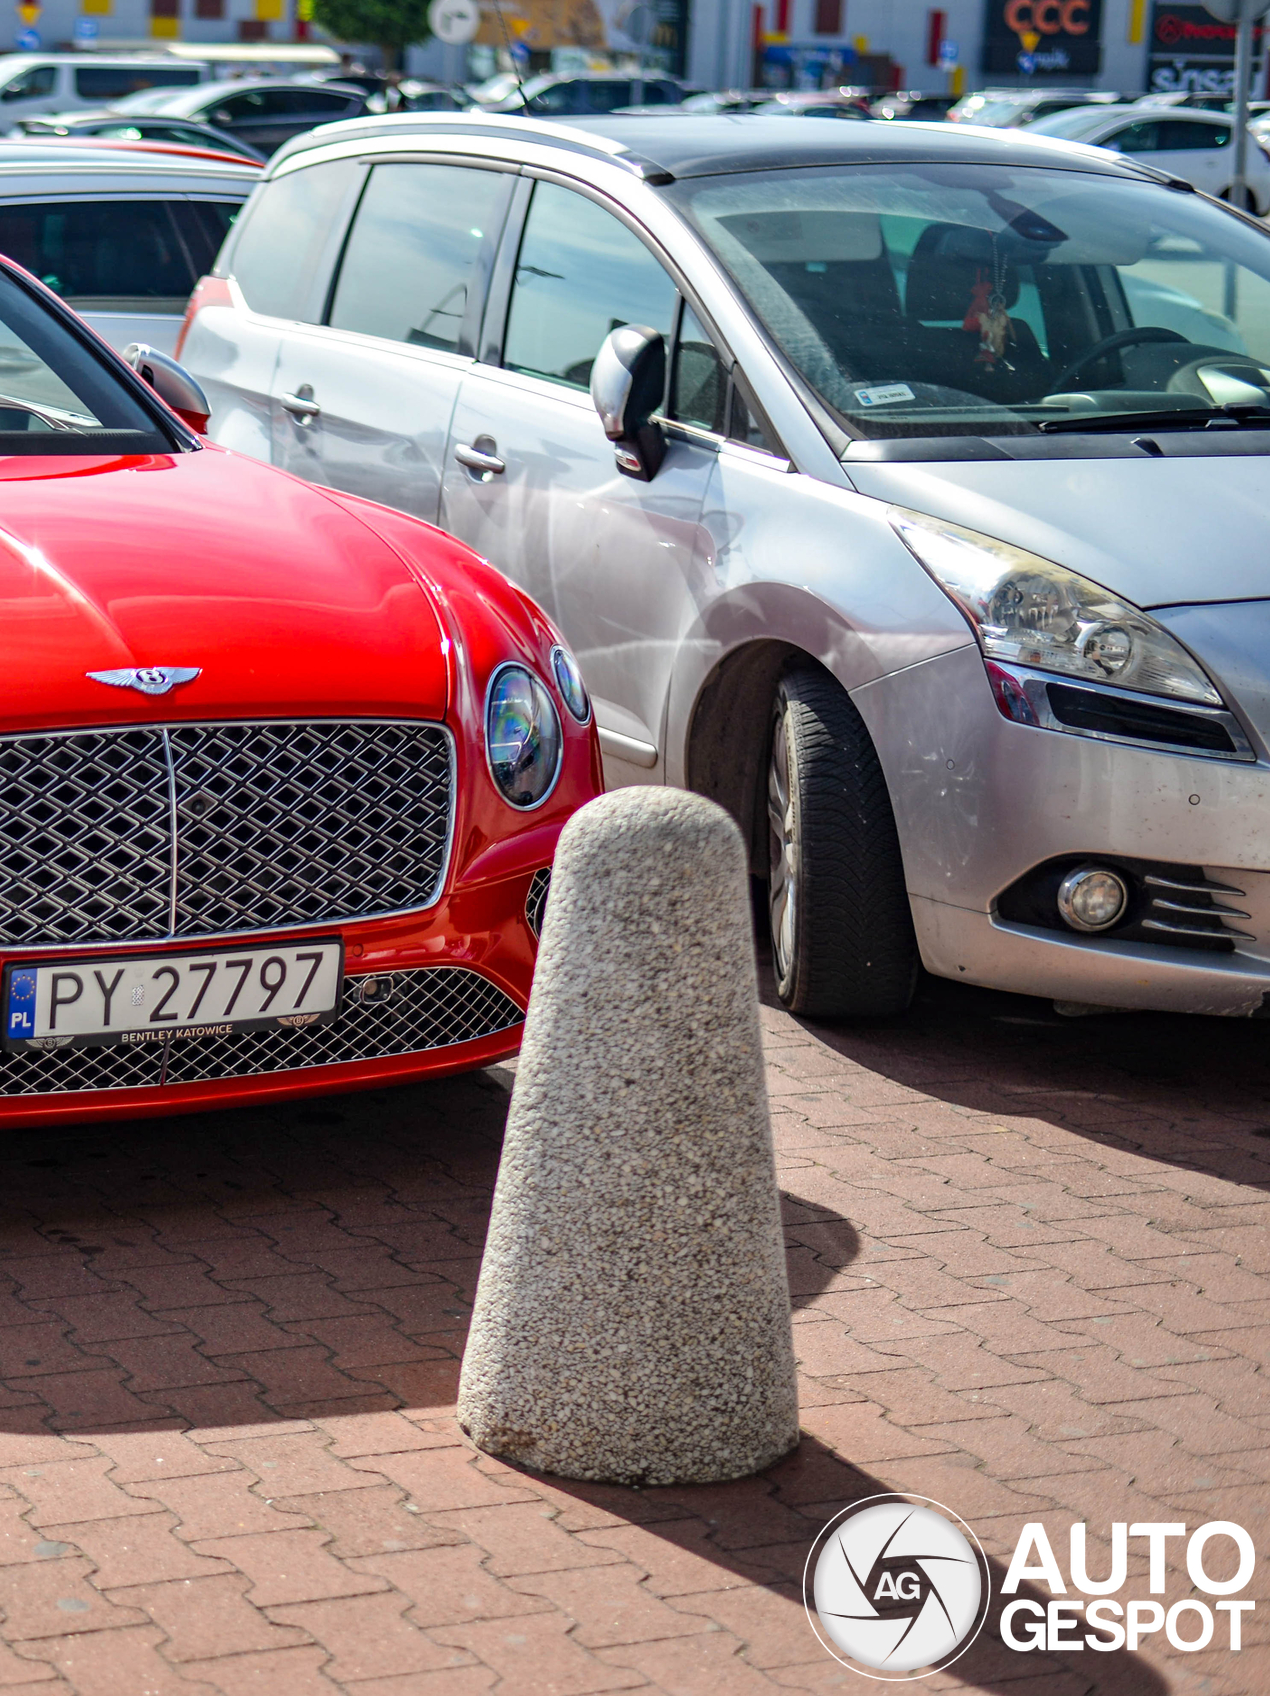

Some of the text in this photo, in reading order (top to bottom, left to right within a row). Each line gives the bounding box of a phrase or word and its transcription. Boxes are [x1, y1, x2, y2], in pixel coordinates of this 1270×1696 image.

[1004, 0, 1090, 35] CCC
[48, 951, 325, 1030] PY 27797
[10, 1011, 32, 1028] PL
[121, 1023, 233, 1043] BENTLEY KATOWICE
